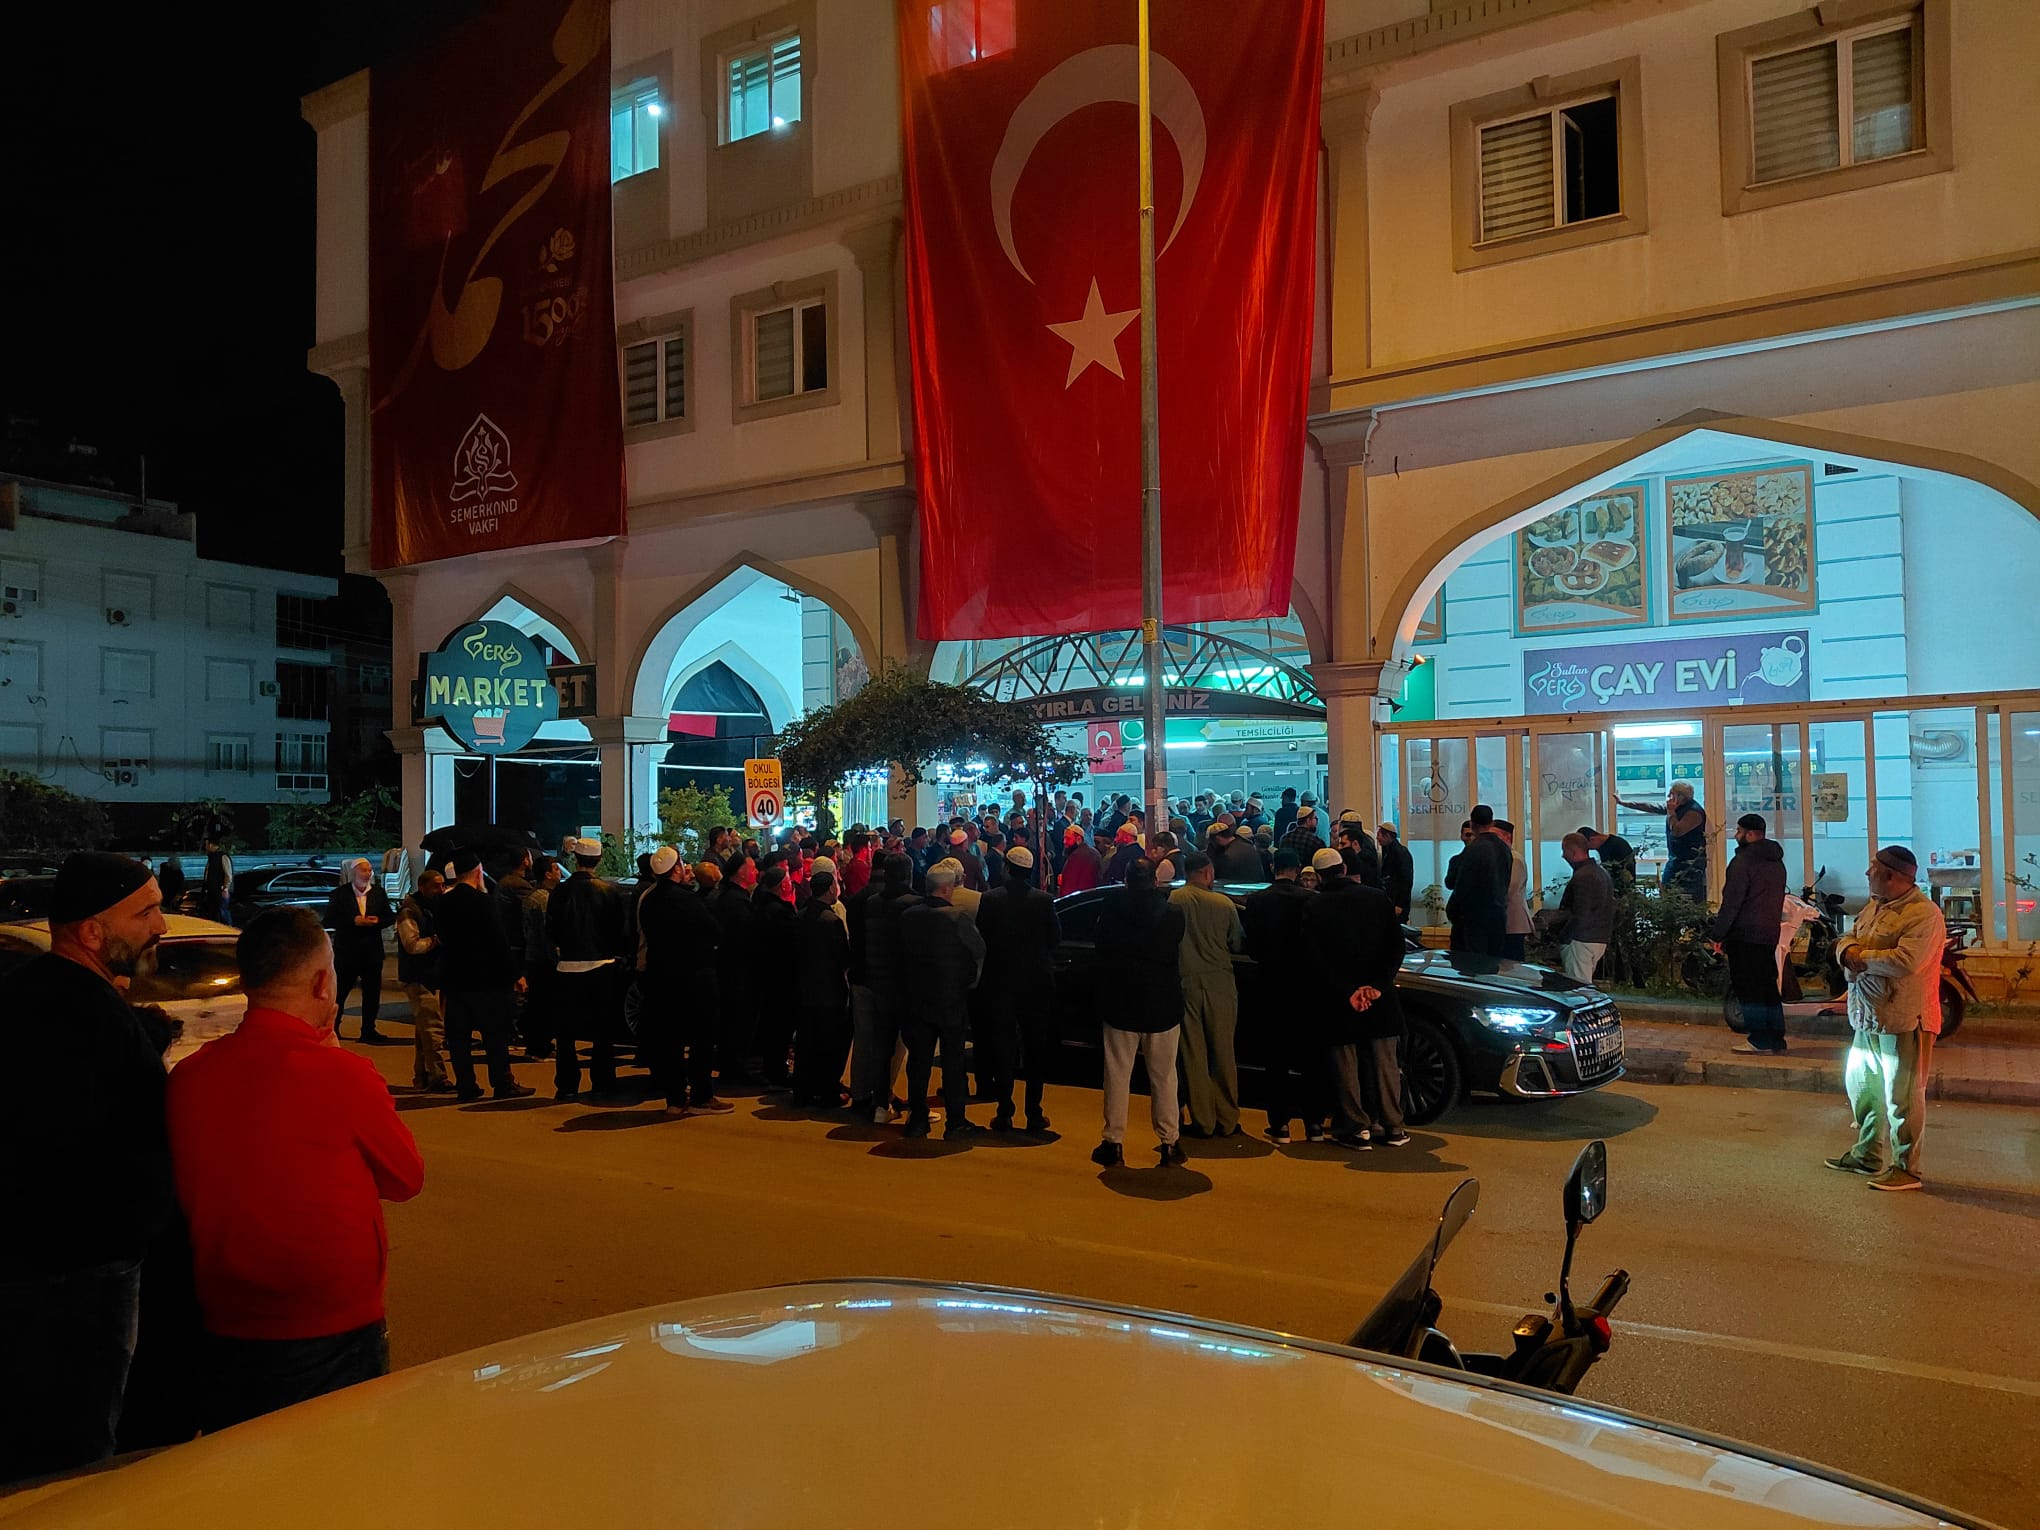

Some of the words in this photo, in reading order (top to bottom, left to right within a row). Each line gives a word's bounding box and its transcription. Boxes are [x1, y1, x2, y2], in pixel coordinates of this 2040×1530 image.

[450, 498, 518, 524] SEMERKAND
[468, 517, 499, 535] VAKFI
[1551, 662, 1589, 678] Sultan
[1589, 661, 1665, 705] ÇAY
[1674, 649, 1738, 693] EVİ
[429, 675, 547, 708] MARKET
[1235, 726, 1294, 738] TEMSİLCİLİĞİ
[753, 763, 773, 774] OKUL
[748, 776, 781, 789] BÖLGESİ
[757, 798, 774, 816] 40
[1408, 801, 1466, 815] SERHENDİ
